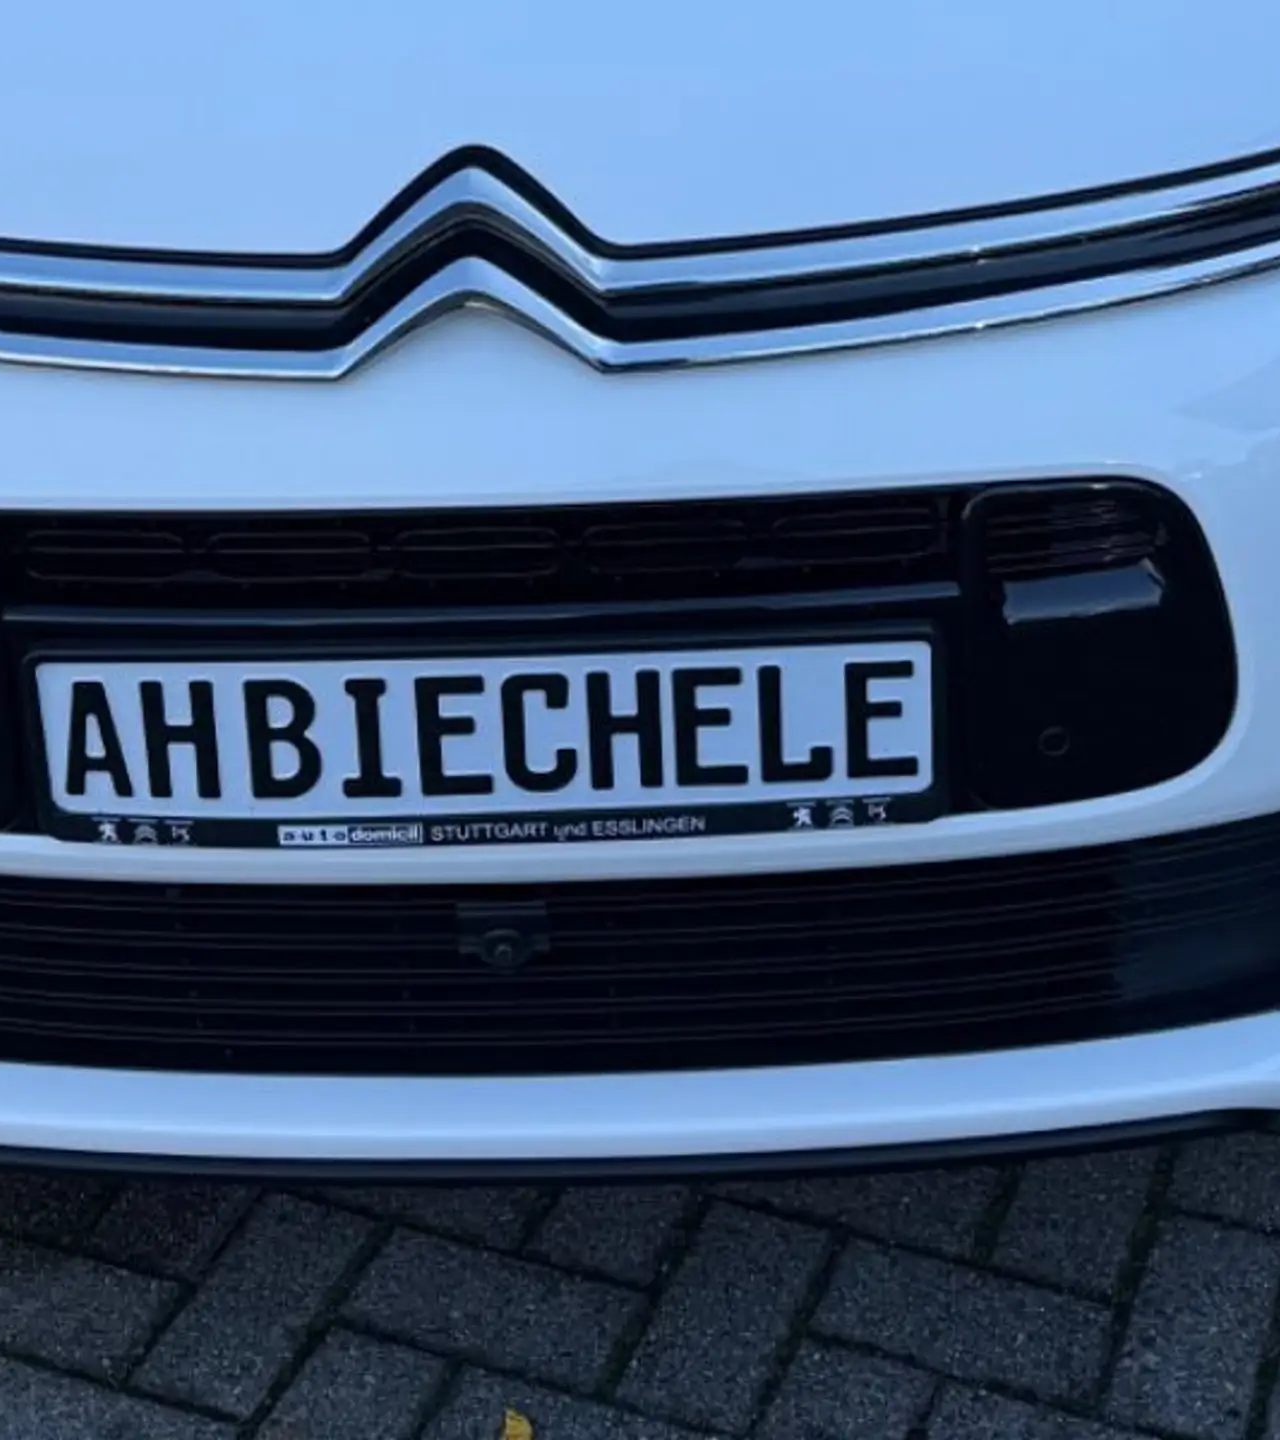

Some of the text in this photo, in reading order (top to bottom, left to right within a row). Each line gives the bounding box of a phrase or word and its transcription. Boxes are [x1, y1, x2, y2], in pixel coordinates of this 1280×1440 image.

[64, 659, 919, 801] AHBIECHELE
[431, 822, 547, 841] STUTTGART
[554, 822, 588, 841] und
[593, 816, 706, 837] ESSLINGEN
